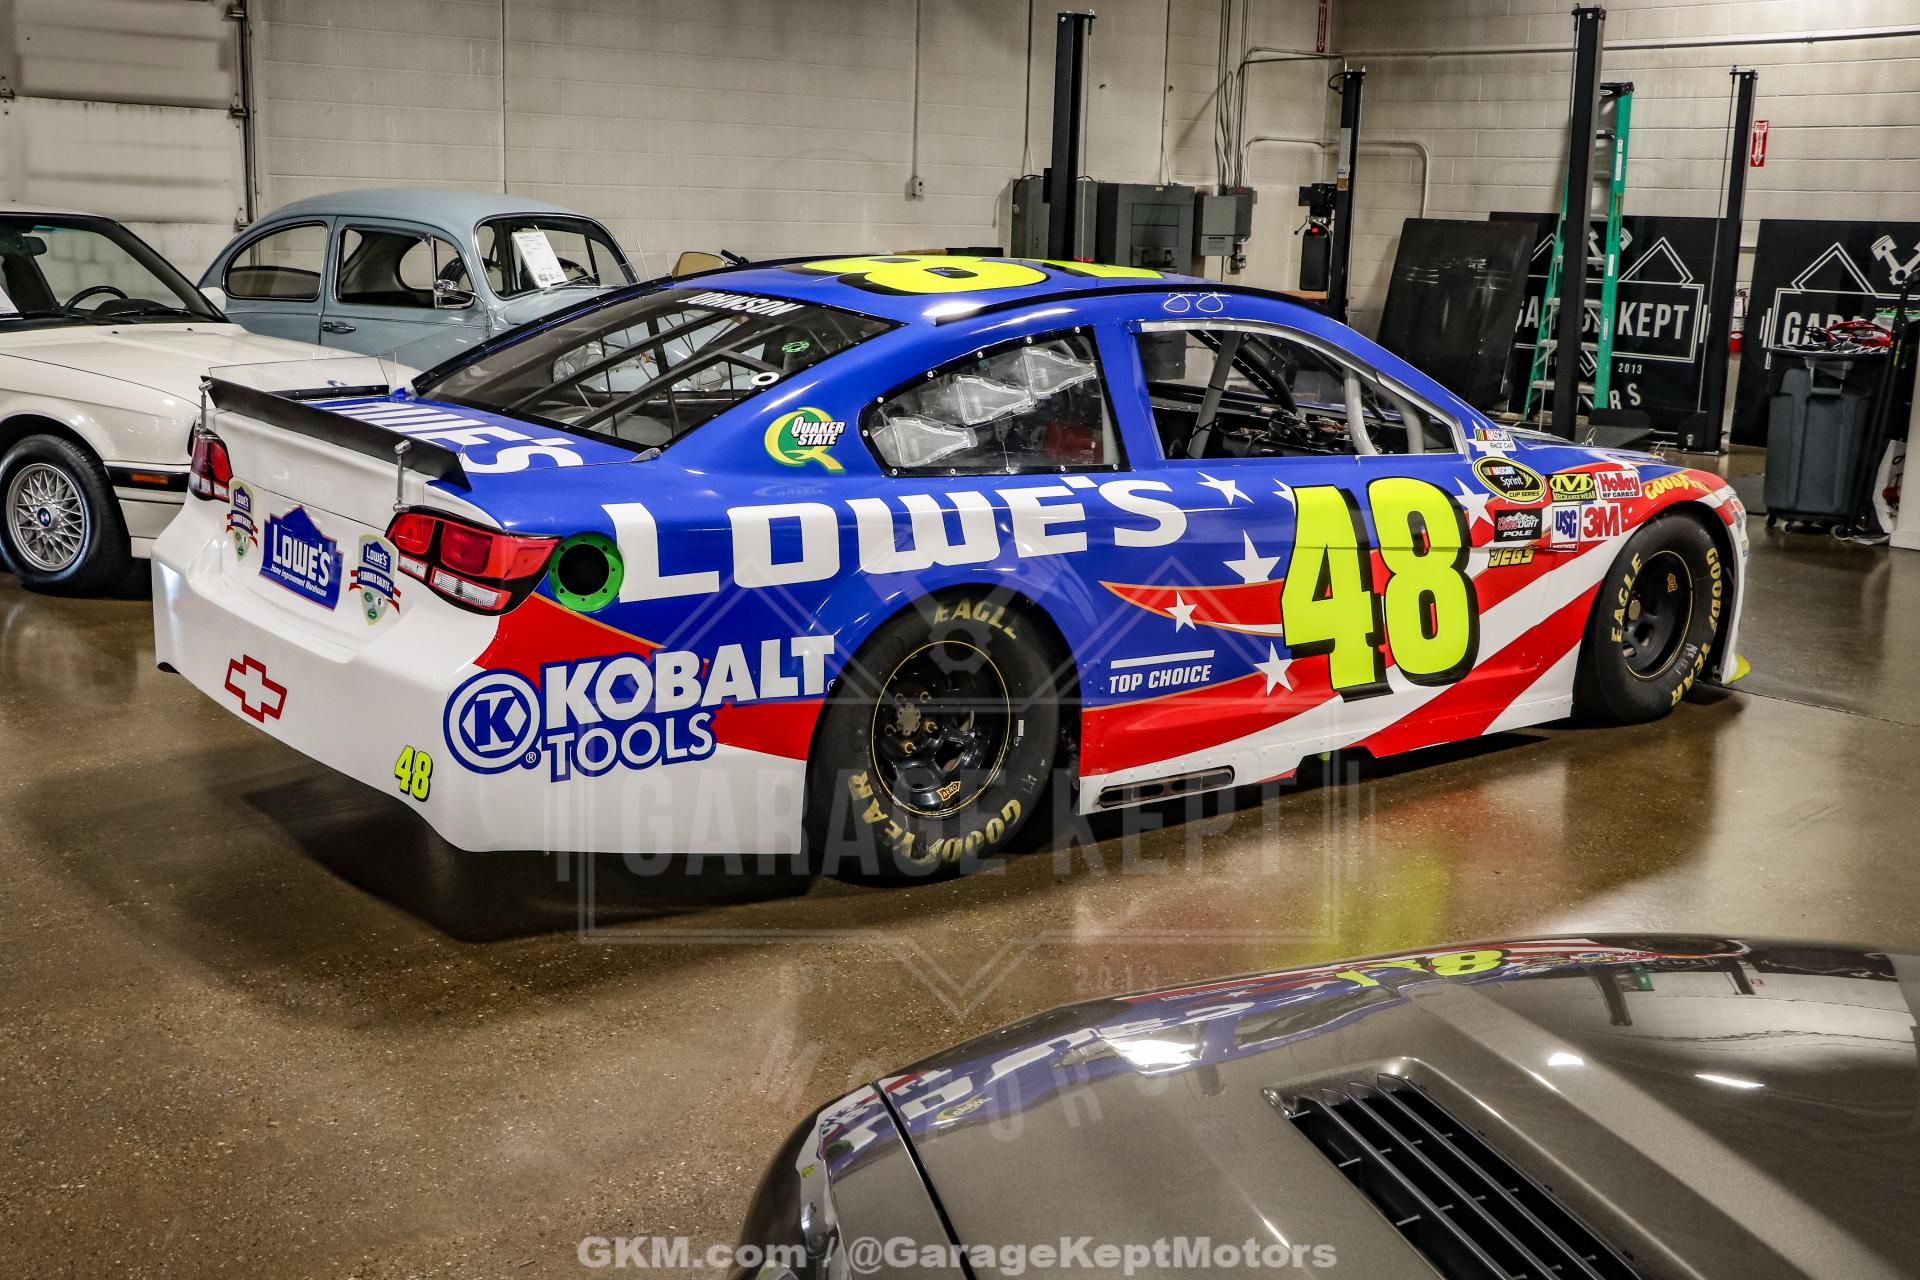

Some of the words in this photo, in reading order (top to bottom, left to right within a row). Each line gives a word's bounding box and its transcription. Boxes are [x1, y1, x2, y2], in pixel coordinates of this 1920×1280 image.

[675, 291, 805, 316] JOHNSON
[1617, 301, 1690, 340] KEPT
[1618, 363, 1643, 374] 2013
[791, 416, 846, 438] QUAKER
[797, 433, 838, 446] STATE
[1487, 430, 1512, 441] NASCAR
[1500, 475, 1524, 488] Sprint
[1598, 473, 1640, 496] Holley
[1518, 519, 1540, 529] LIGHT
[1555, 510, 1577, 539] USG
[1583, 506, 1620, 538] 3M
[600, 475, 1188, 603] LOWE'S
[272, 524, 331, 587] LOWE'S
[366, 545, 388, 567] LOWE'S
[1488, 548, 1534, 567] JEGS
[1281, 476, 1480, 703] 48
[1611, 552, 1643, 643] EAGLE
[545, 634, 835, 729] KOBALT
[1110, 674, 1143, 694] TOP
[1148, 664, 1212, 688] CHOICE
[547, 712, 714, 778] TOOLS
[394, 745, 433, 802] 48
[941, 783, 959, 799] AERO
